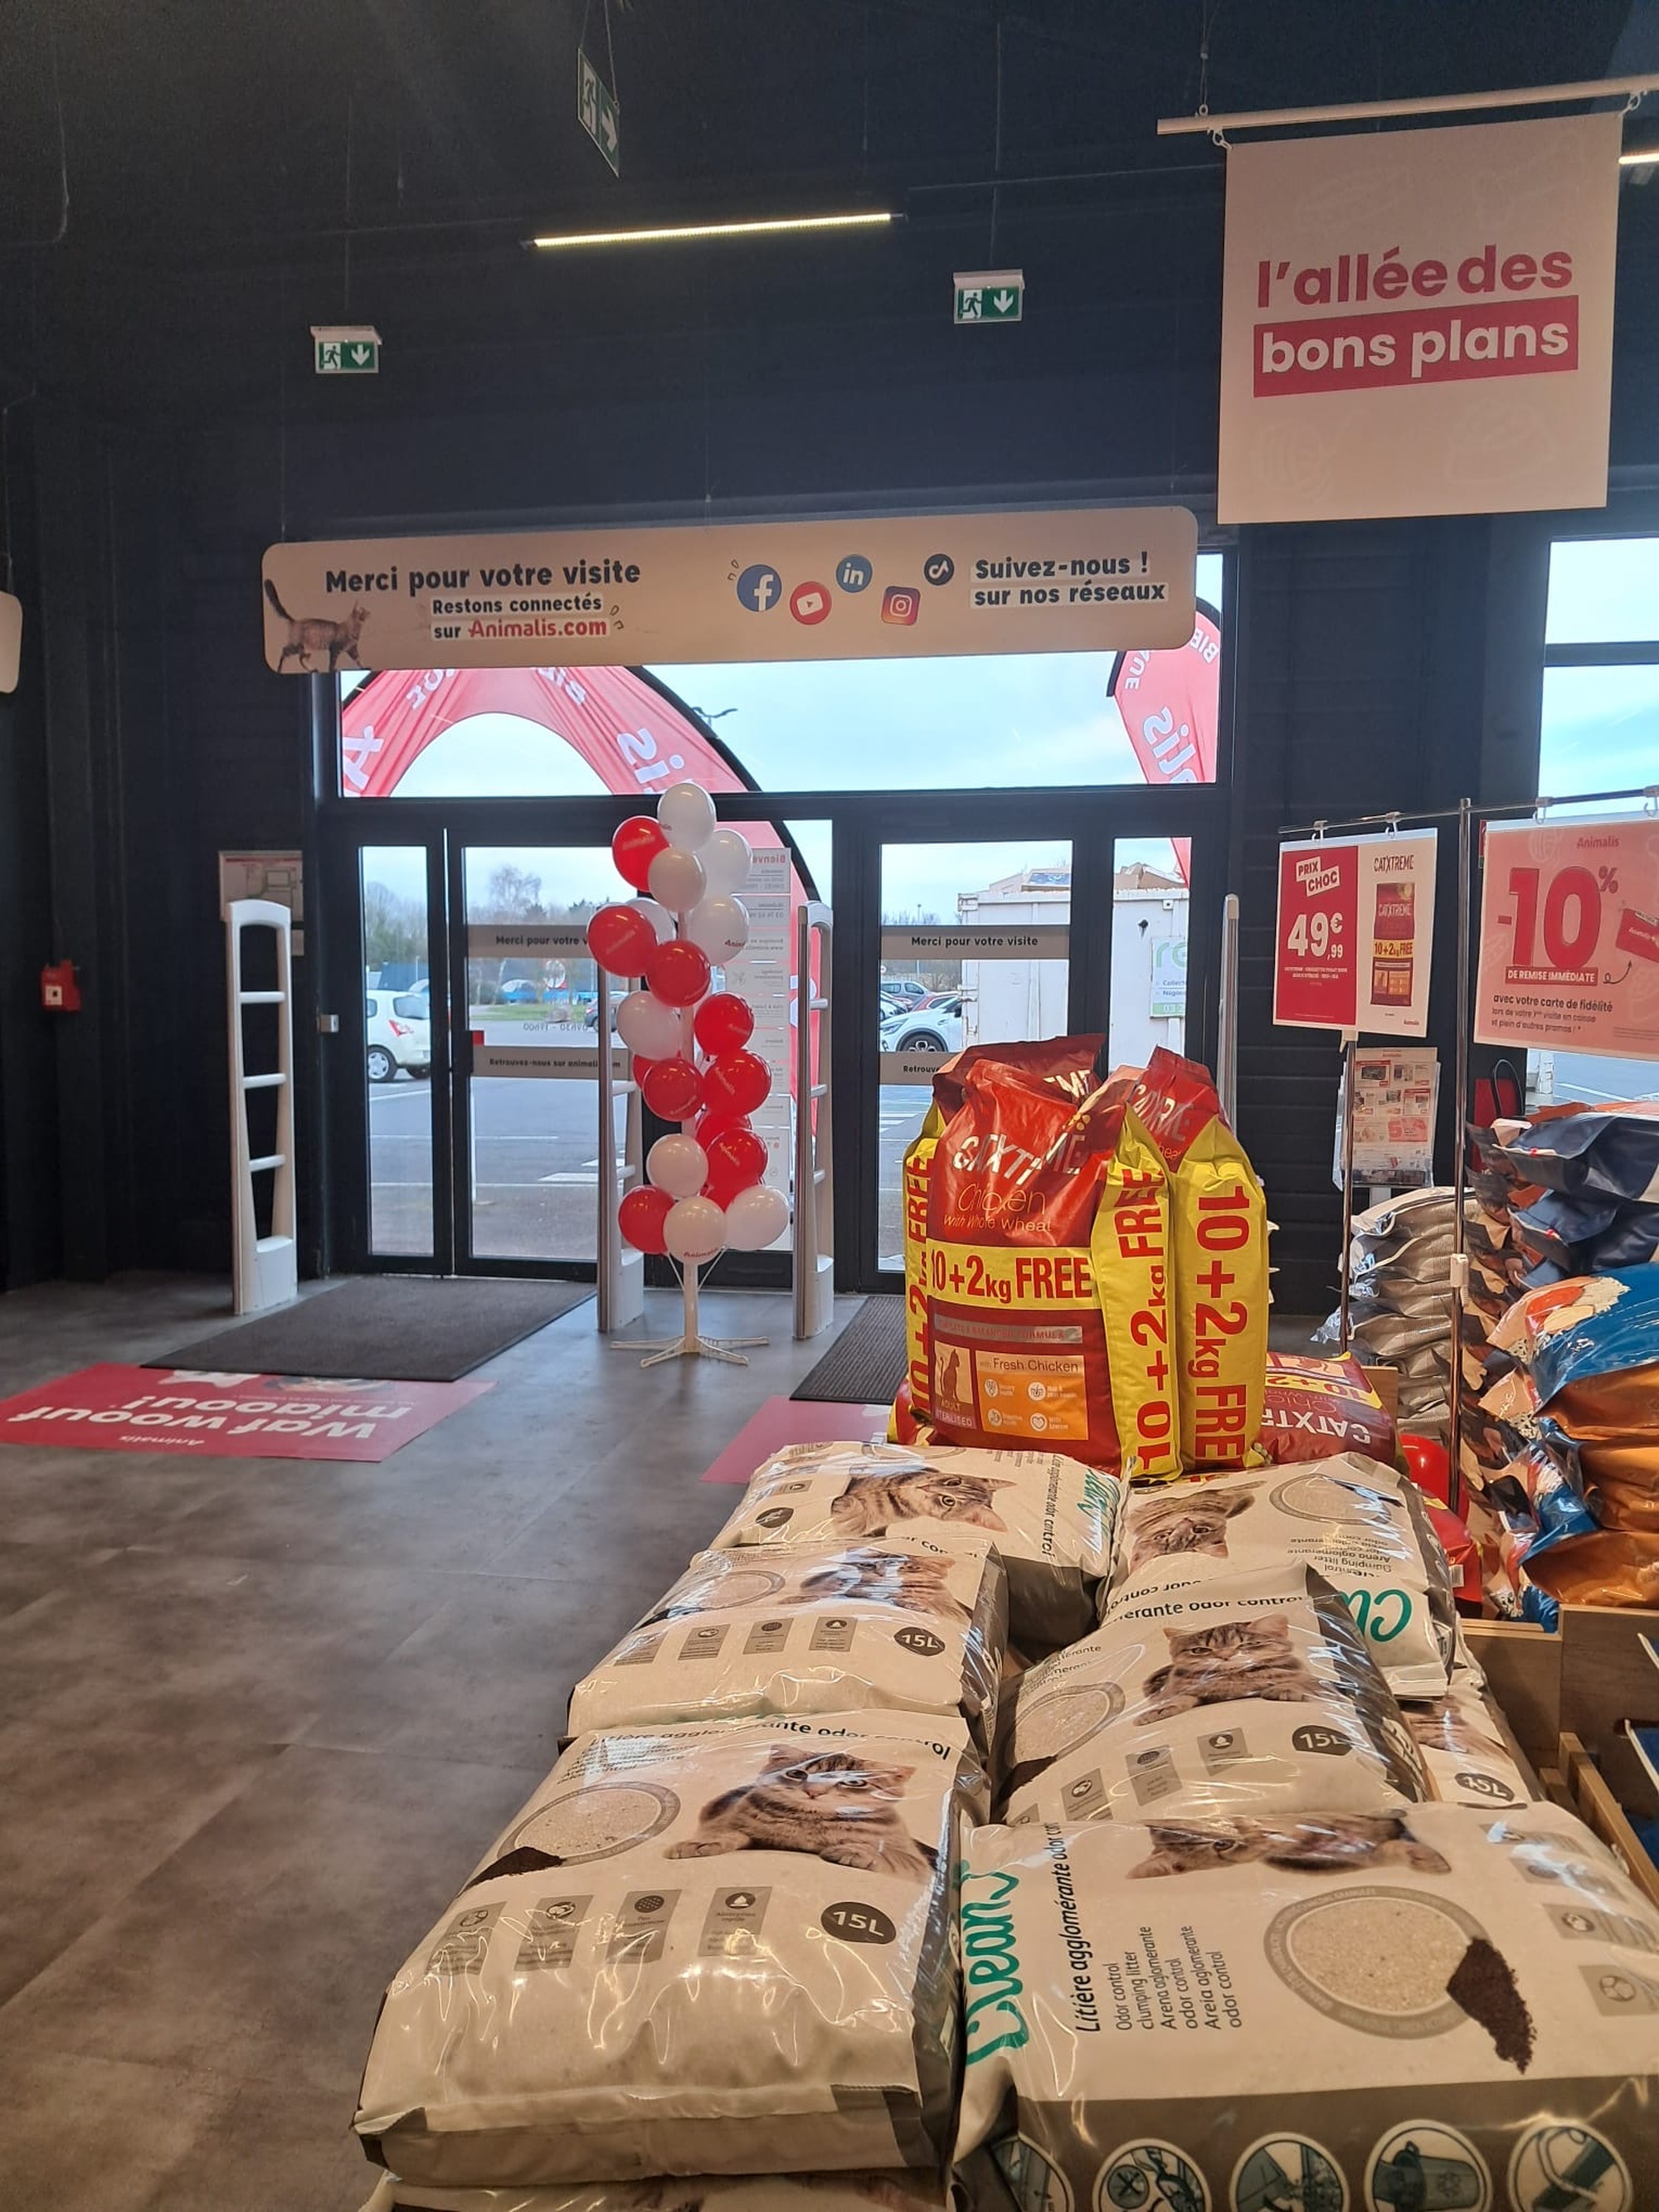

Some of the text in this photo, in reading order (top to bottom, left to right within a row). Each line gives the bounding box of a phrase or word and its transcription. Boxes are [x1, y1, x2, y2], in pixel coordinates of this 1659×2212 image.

[1258, 245, 1573, 308] l'allée des
[1262, 320, 1569, 378] bons plans
[326, 559, 640, 596] Merci pour votre visite
[975, 557, 1130, 579] Suivez-nous
[433, 592, 601, 615] Restons connectés
[975, 581, 1165, 605] sur nos réseaux
[434, 618, 607, 639] sur Animalis.com
[1577, 837, 1619, 848] Animalis
[1297, 860, 1319, 877] PRIX
[1374, 855, 1414, 872] CATXTREME
[1307, 871, 1338, 892] CHOC
[496, 936, 579, 947] Merci pour votre
[912, 936, 1039, 949] Merci pour votre visite
[1399, 942, 1413, 955] FREE
[1507, 970, 1519, 979] DE
[1519, 971, 1547, 980] REMISE
[1493, 994, 1613, 1012] avec votre carte de fidélité
[489, 1058, 551, 1067] Retrouvez-nous
[1114, 1167, 1166, 1259] FREE
[1015, 1257, 1093, 1300] FREE
[1187, 1185, 1251, 1379] 10+2kg
[993, 1357, 1079, 1373] Fresh Chicken
[8, 1405, 377, 1439] Waf woouf
[119, 1434, 206, 1446] Animalis
[902, 1634, 939, 1649] 15L
[1464, 1776, 1507, 1798] 15L
[832, 1911, 885, 1939] 15L
[1043, 1837, 1102, 2034] Litière agglomérante odor
[1139, 1926, 1177, 2030] Arena aglomerante
[1180, 1925, 1223, 2030] Areia aglomerante
[1103, 1962, 1133, 2031] Odor control
[1125, 1951, 1155, 2030] clumping litter
[1165, 1957, 1199, 2030] odor control
[1205, 1951, 1243, 2029] odor control
